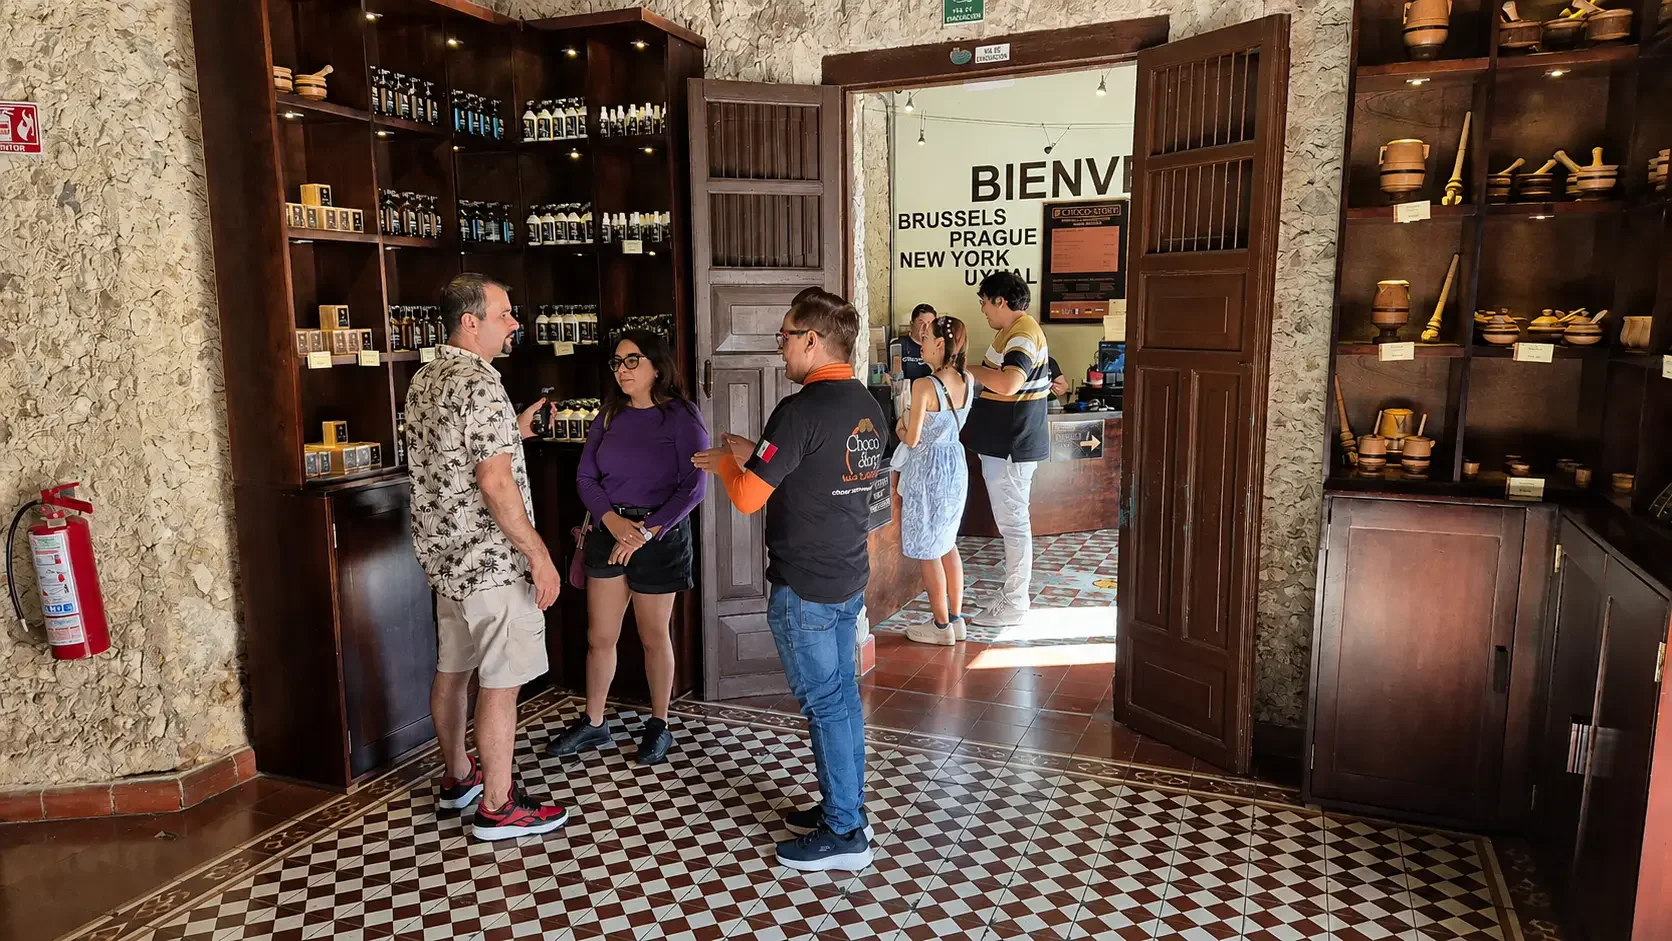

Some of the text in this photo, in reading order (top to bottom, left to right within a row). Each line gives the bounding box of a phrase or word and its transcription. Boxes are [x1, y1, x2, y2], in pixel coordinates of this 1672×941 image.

[898, 208, 1007, 230] BRUSSELS
[950, 228, 1037, 248] PRAGUE
[900, 249, 1010, 268] NEW YORK
[965, 268, 1038, 286] UXL
[846, 434, 880, 452] Choco
